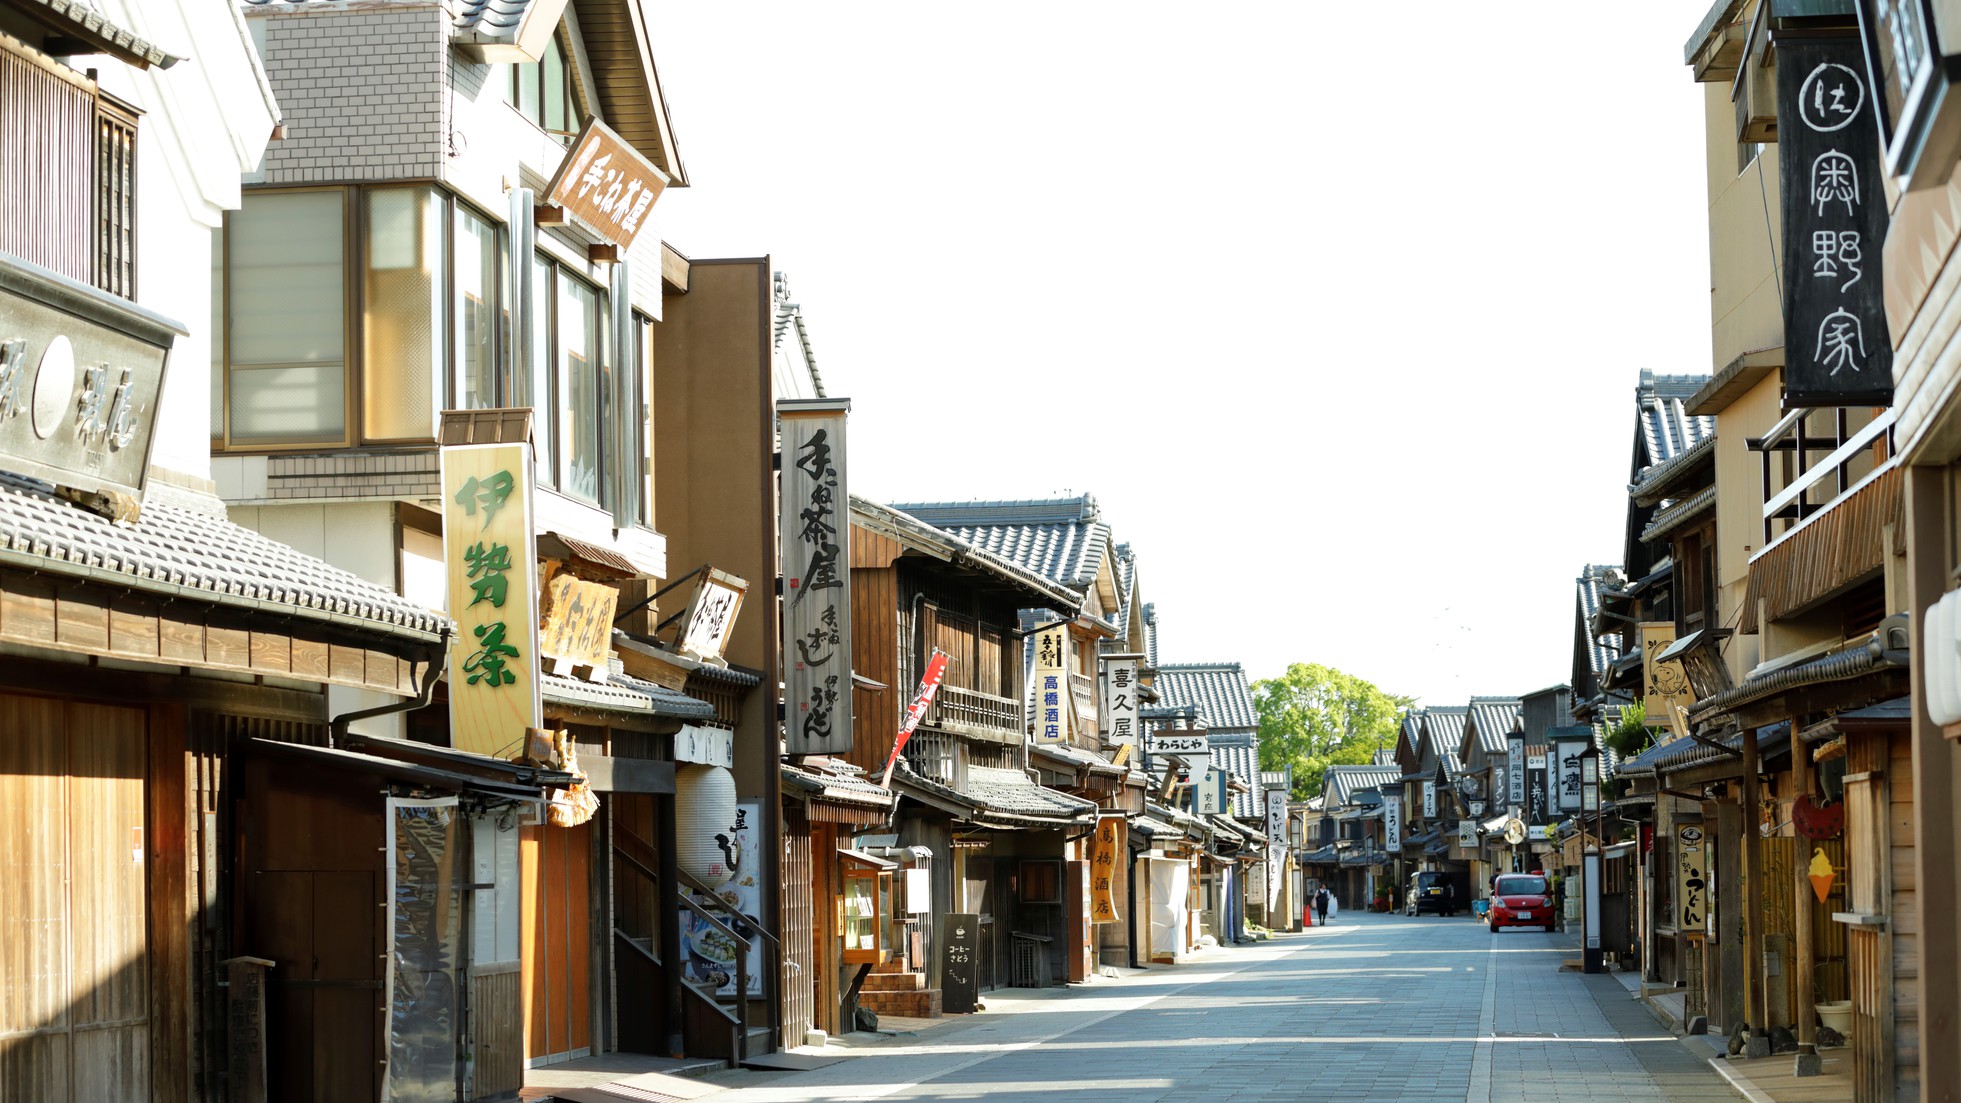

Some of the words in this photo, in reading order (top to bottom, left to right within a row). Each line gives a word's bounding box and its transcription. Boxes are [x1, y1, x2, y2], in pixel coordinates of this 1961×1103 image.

[578, 153, 654, 235] 手こね茶屋
[1811, 148, 1866, 376] 奥野家
[790, 429, 843, 608] 手こね茶屋
[455, 469, 519, 687] 伊勢茶
[804, 687, 833, 739] うどん
[1044, 676, 1059, 738] 高橋酒店
[1111, 668, 1133, 737] 喜久屋
[1158, 739, 1202, 750] わらじや
[1495, 768, 1505, 805] ラーメン
[1271, 812, 1283, 843] ひげ天
[1095, 827, 1113, 914] 高橋酒店
[1684, 868, 1704, 925] うどん
[950, 955, 968, 963] さとう
